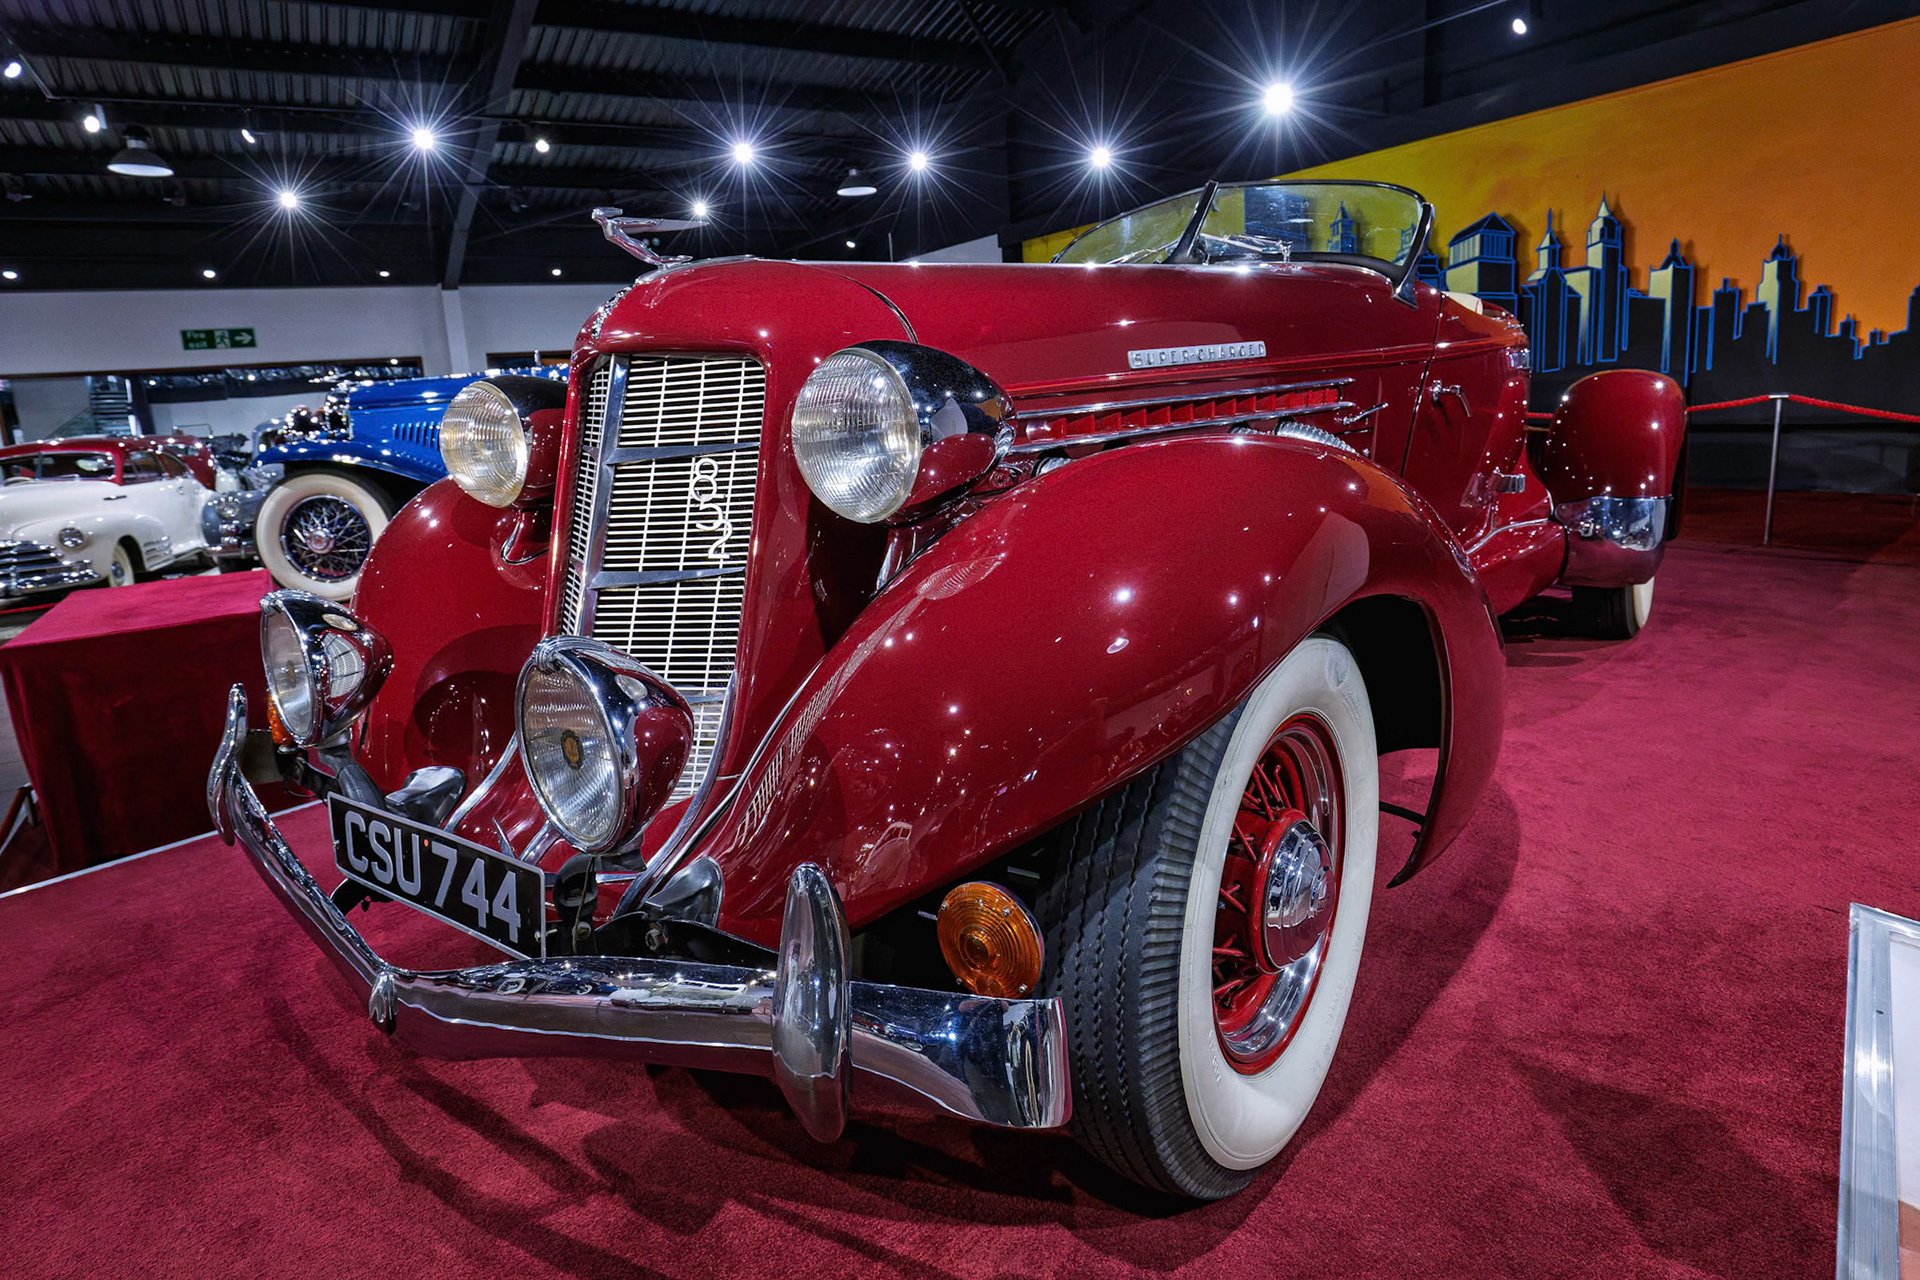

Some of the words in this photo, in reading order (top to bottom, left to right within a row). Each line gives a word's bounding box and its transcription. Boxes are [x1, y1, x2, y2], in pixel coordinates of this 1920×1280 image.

[1132, 342, 1266, 367] SUPER-CHARGED
[691, 457, 733, 559] 852
[344, 811, 421, 896] CSU
[431, 840, 521, 944] 744
